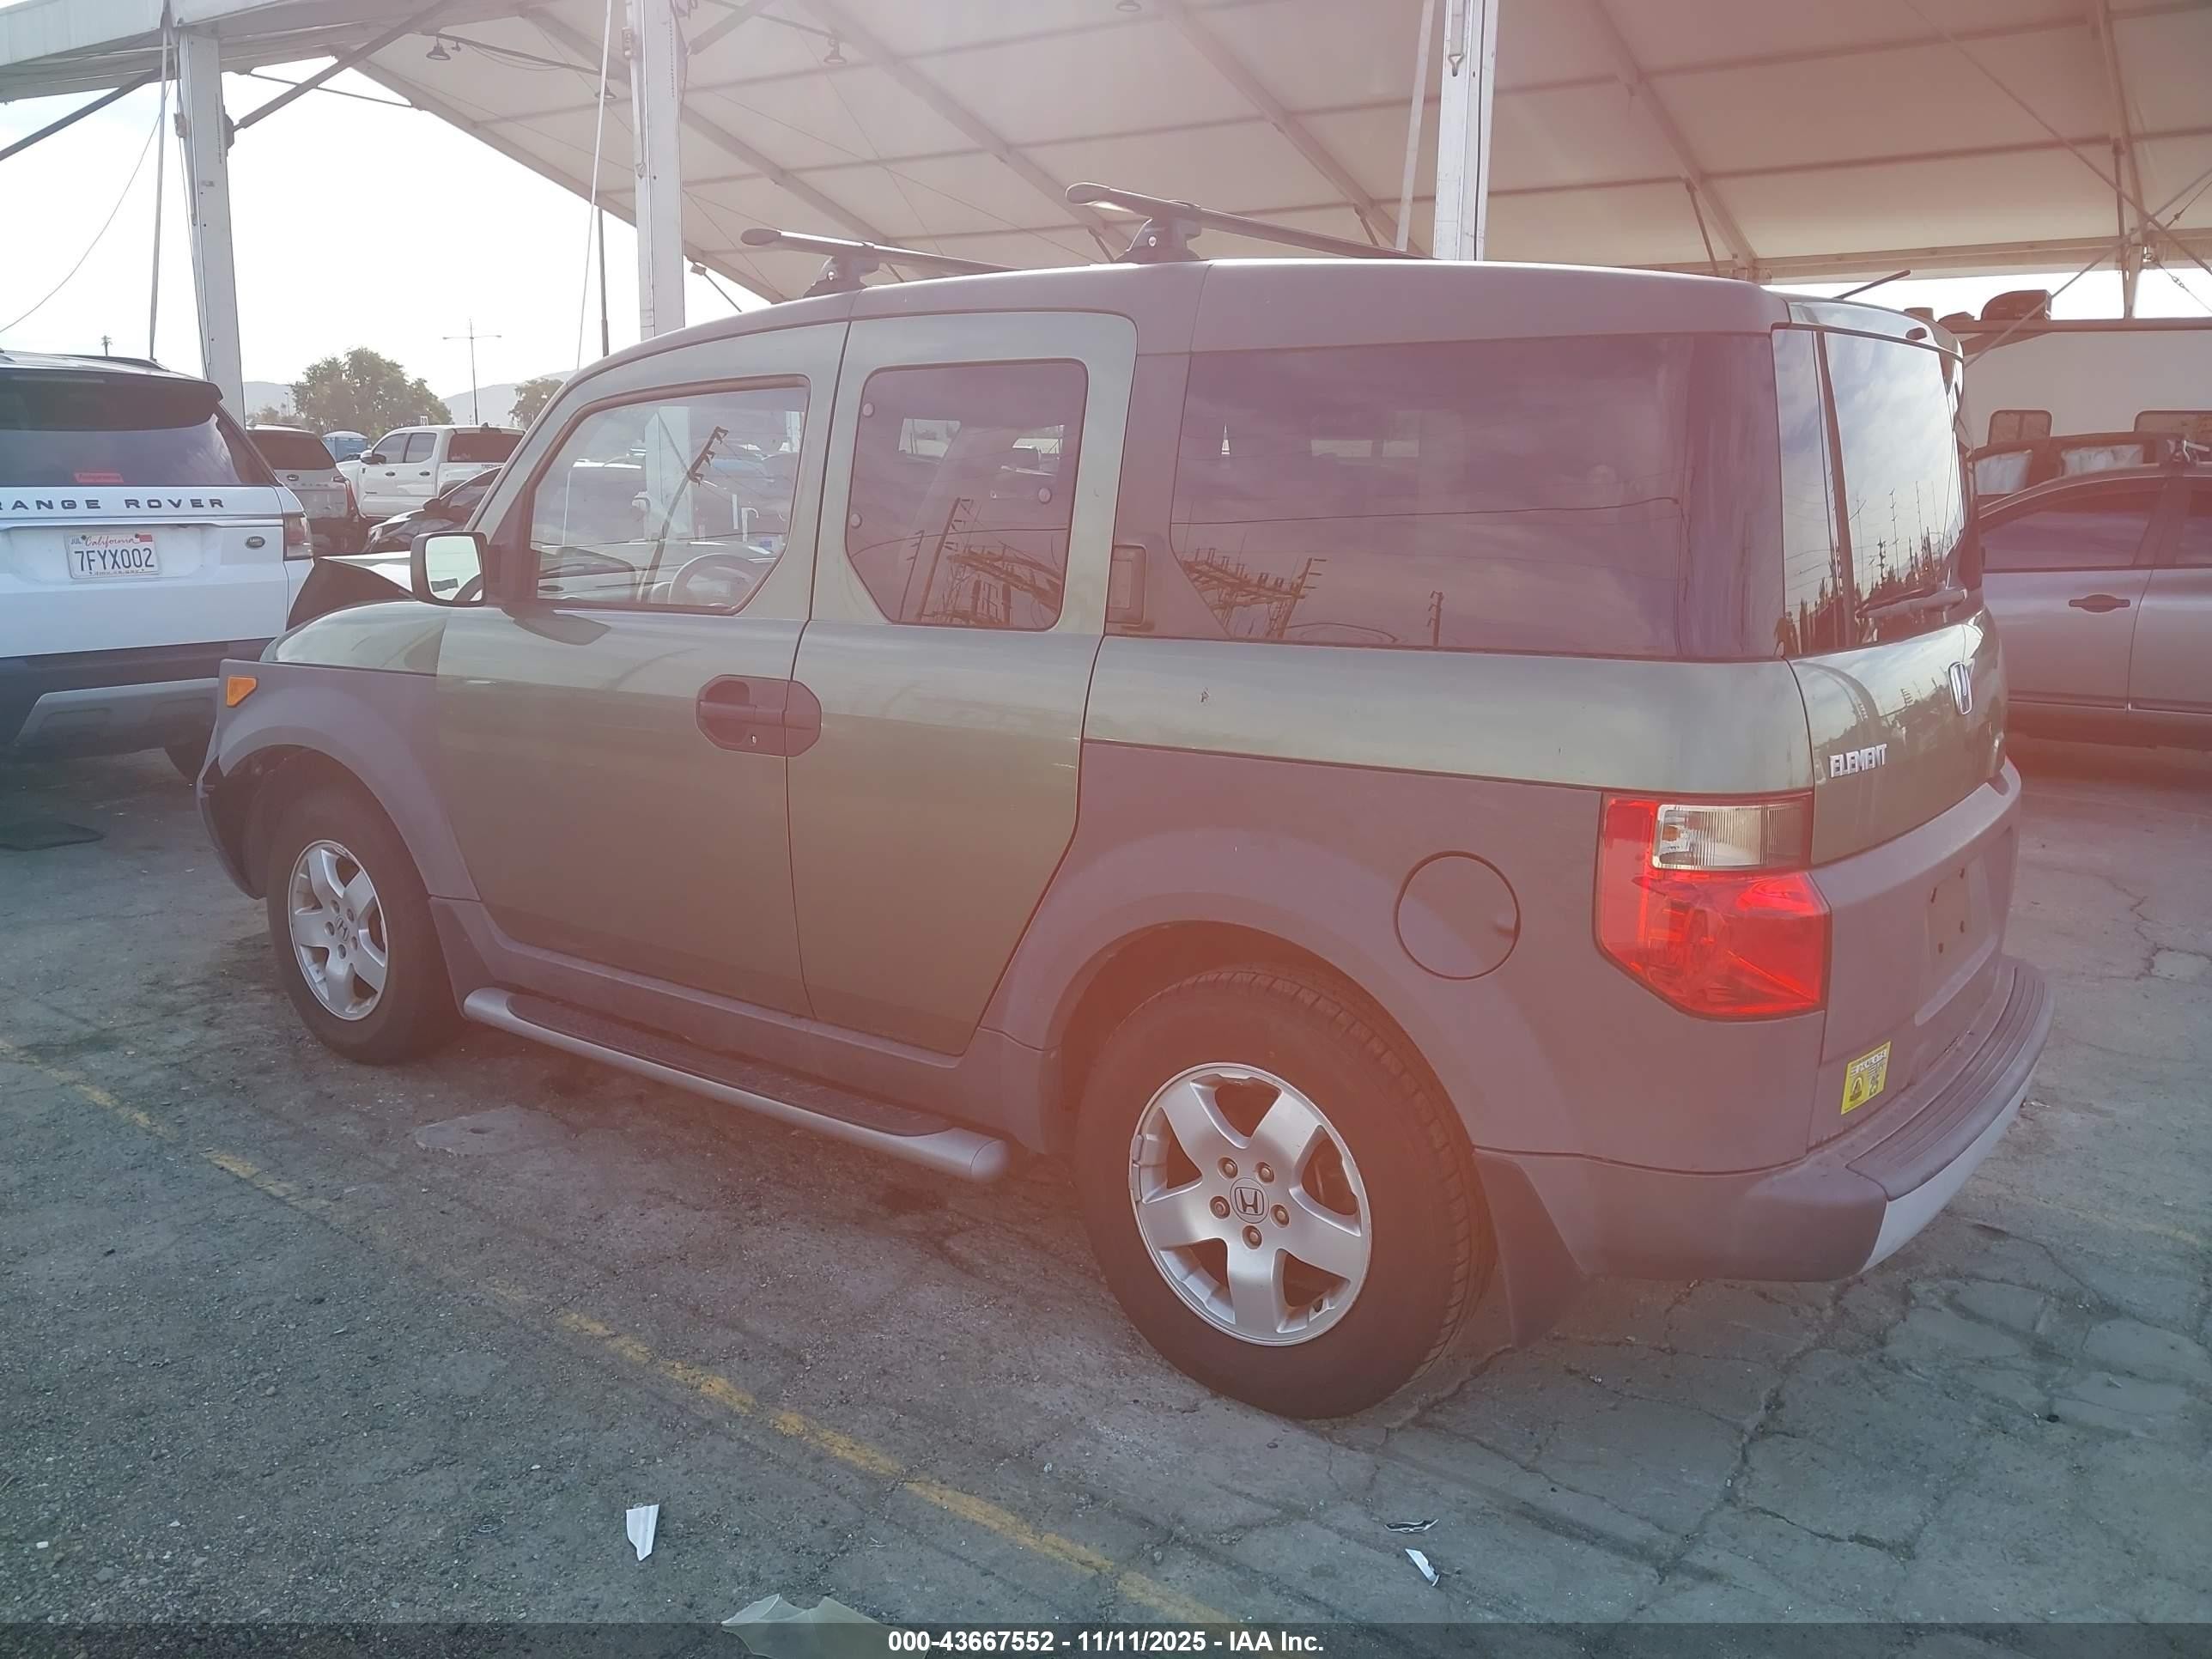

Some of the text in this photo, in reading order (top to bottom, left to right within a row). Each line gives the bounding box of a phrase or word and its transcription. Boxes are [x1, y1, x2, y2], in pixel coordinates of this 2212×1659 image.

[0, 499, 223, 510] ANGE ROVER
[85, 535, 139, 548] California
[74, 548, 155, 571] 7FYX002
[1828, 743, 1887, 778] ELEMENT
